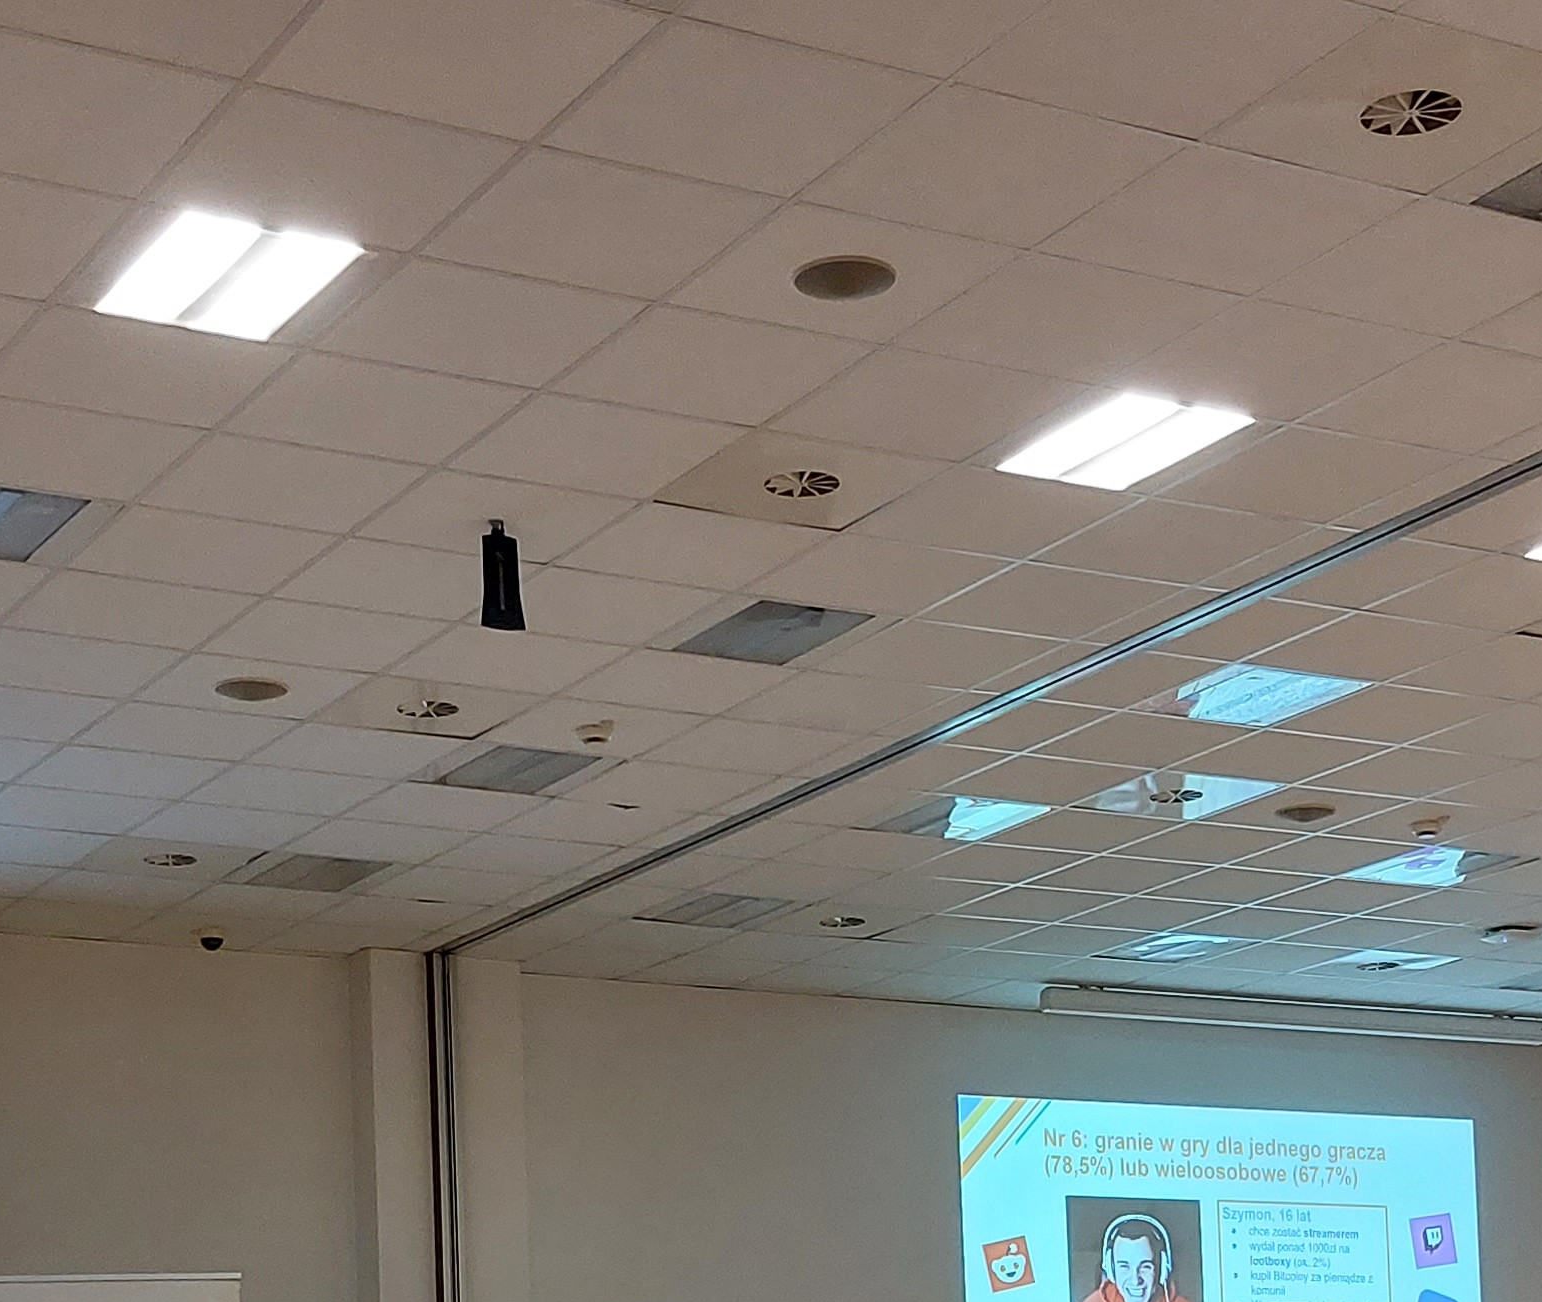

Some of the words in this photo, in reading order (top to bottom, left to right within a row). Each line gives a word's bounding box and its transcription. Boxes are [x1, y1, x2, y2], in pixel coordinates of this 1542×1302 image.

[1044, 1128, 1065, 1147] Nr
[1071, 1130, 1088, 1149] 6:
[1095, 1132, 1153, 1153] granie
[1159, 1137, 1174, 1152] w
[1181, 1139, 1209, 1158] gry
[1217, 1136, 1243, 1156] dla
[1249, 1139, 1321, 1162] jednego
[1327, 1144, 1385, 1163] gracza
[1044, 1155, 1115, 1180] (78,5%)
[1120, 1158, 1148, 1177] lub
[1155, 1160, 1287, 1182] wieloosobowe
[1293, 1165, 1359, 1189] (67,7%)
[1223, 1207, 1275, 1223] Szymon,
[1279, 1209, 1293, 1221] 16
[1296, 1209, 1311, 1222] lat
[1339, 1245, 1349, 1253] na
